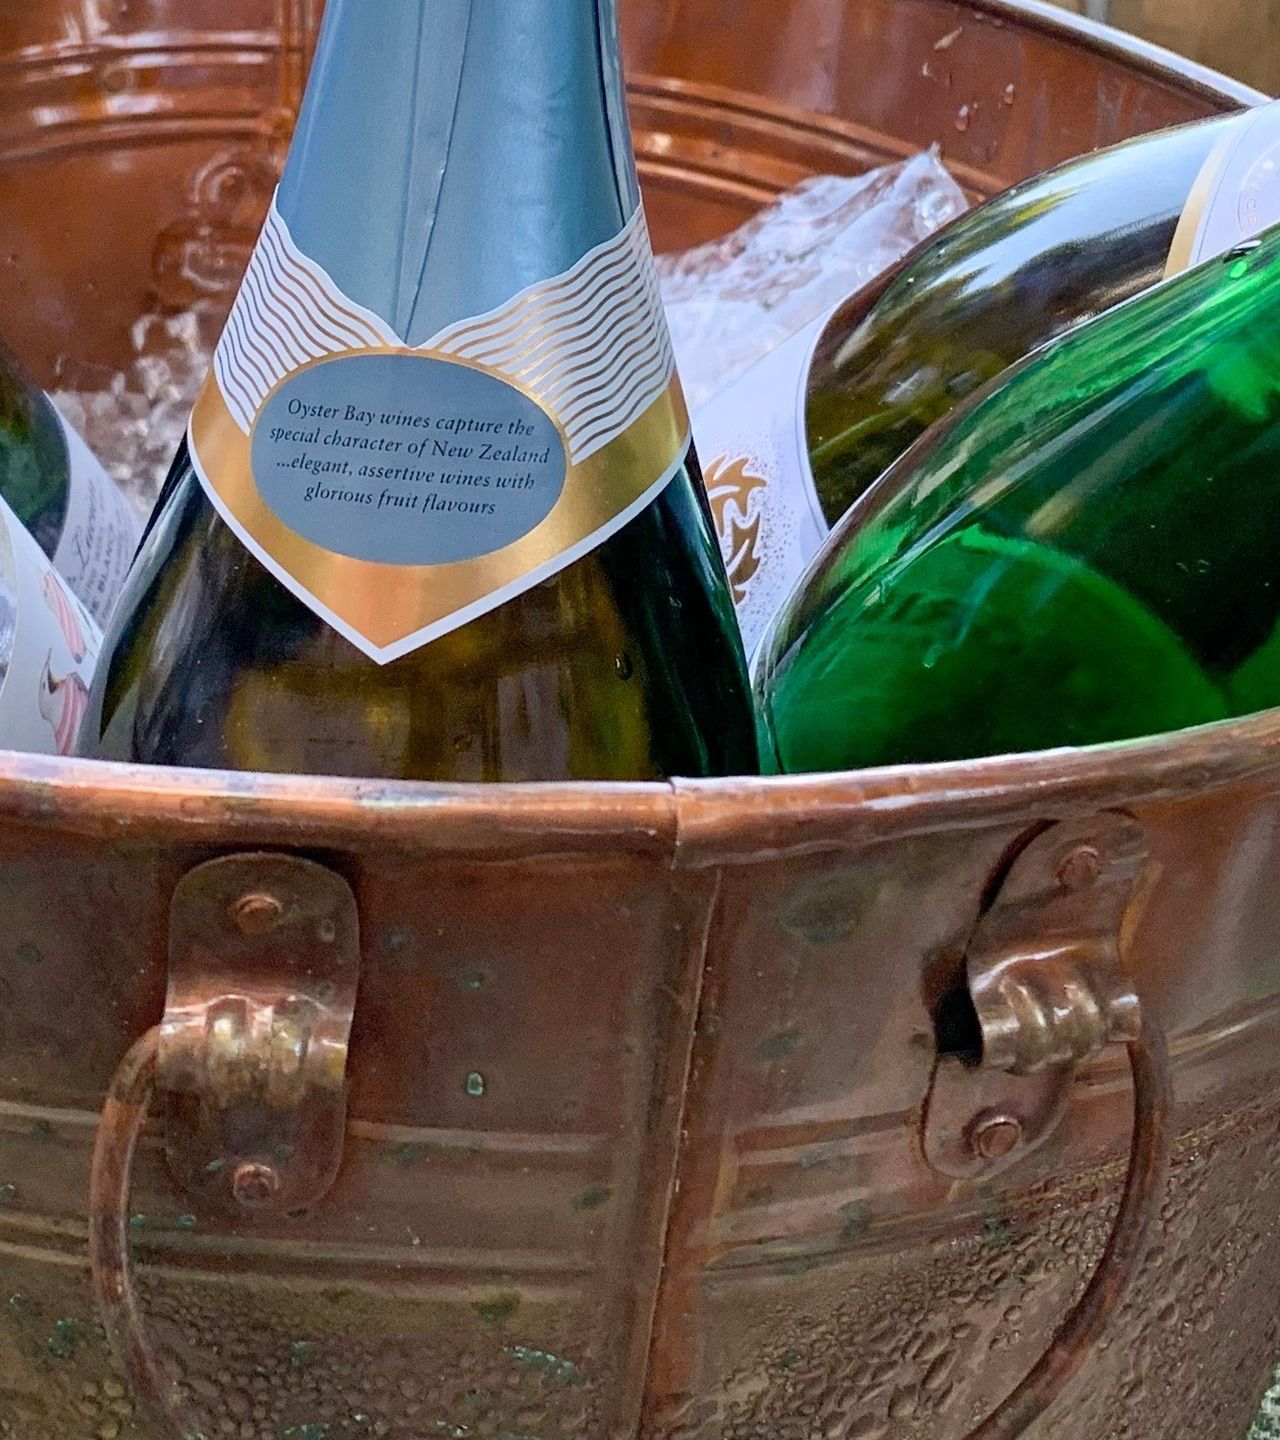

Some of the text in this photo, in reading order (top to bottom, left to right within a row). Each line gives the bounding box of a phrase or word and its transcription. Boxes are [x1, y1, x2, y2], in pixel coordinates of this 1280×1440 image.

[287, 398, 535, 437] Oyster Bay wines capture the
[269, 426, 551, 464] special character of New Zealand
[357, 462, 435, 483] assertive
[439, 470, 490, 488] wines
[495, 471, 535, 490] with
[304, 483, 496, 515] glorious fruit flavours
